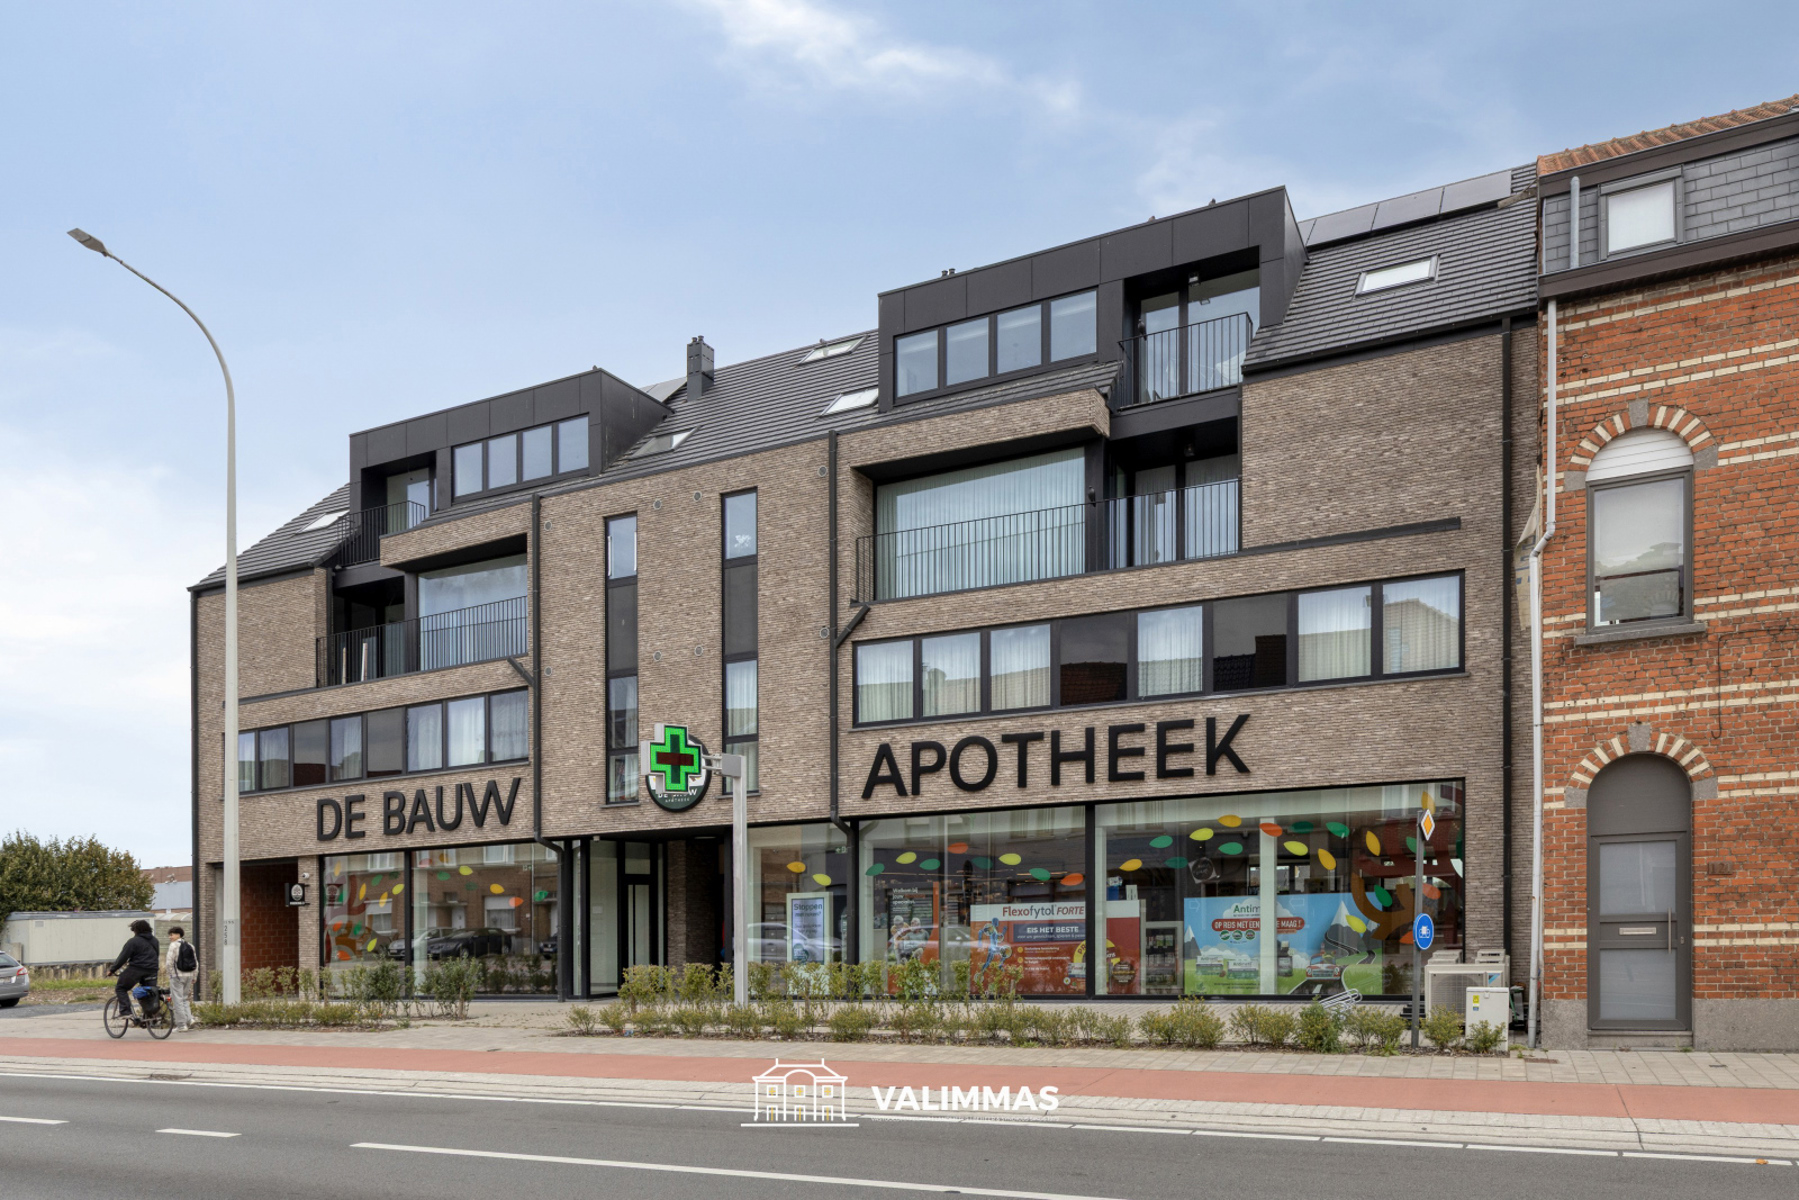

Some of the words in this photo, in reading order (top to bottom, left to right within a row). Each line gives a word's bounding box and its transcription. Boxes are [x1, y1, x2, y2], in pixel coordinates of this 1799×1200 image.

[861, 714, 1251, 800] APOTHEEK
[317, 794, 365, 841] DE
[383, 777, 521, 835] BAUW
[1056, 906, 1085, 915] FORTE
[1232, 904, 1260, 913] Antim
[1214, 921, 1222, 929] OP
[1237, 920, 1248, 928] MET
[1249, 920, 1260, 928] EEN
[1281, 919, 1297, 927] MAAG
